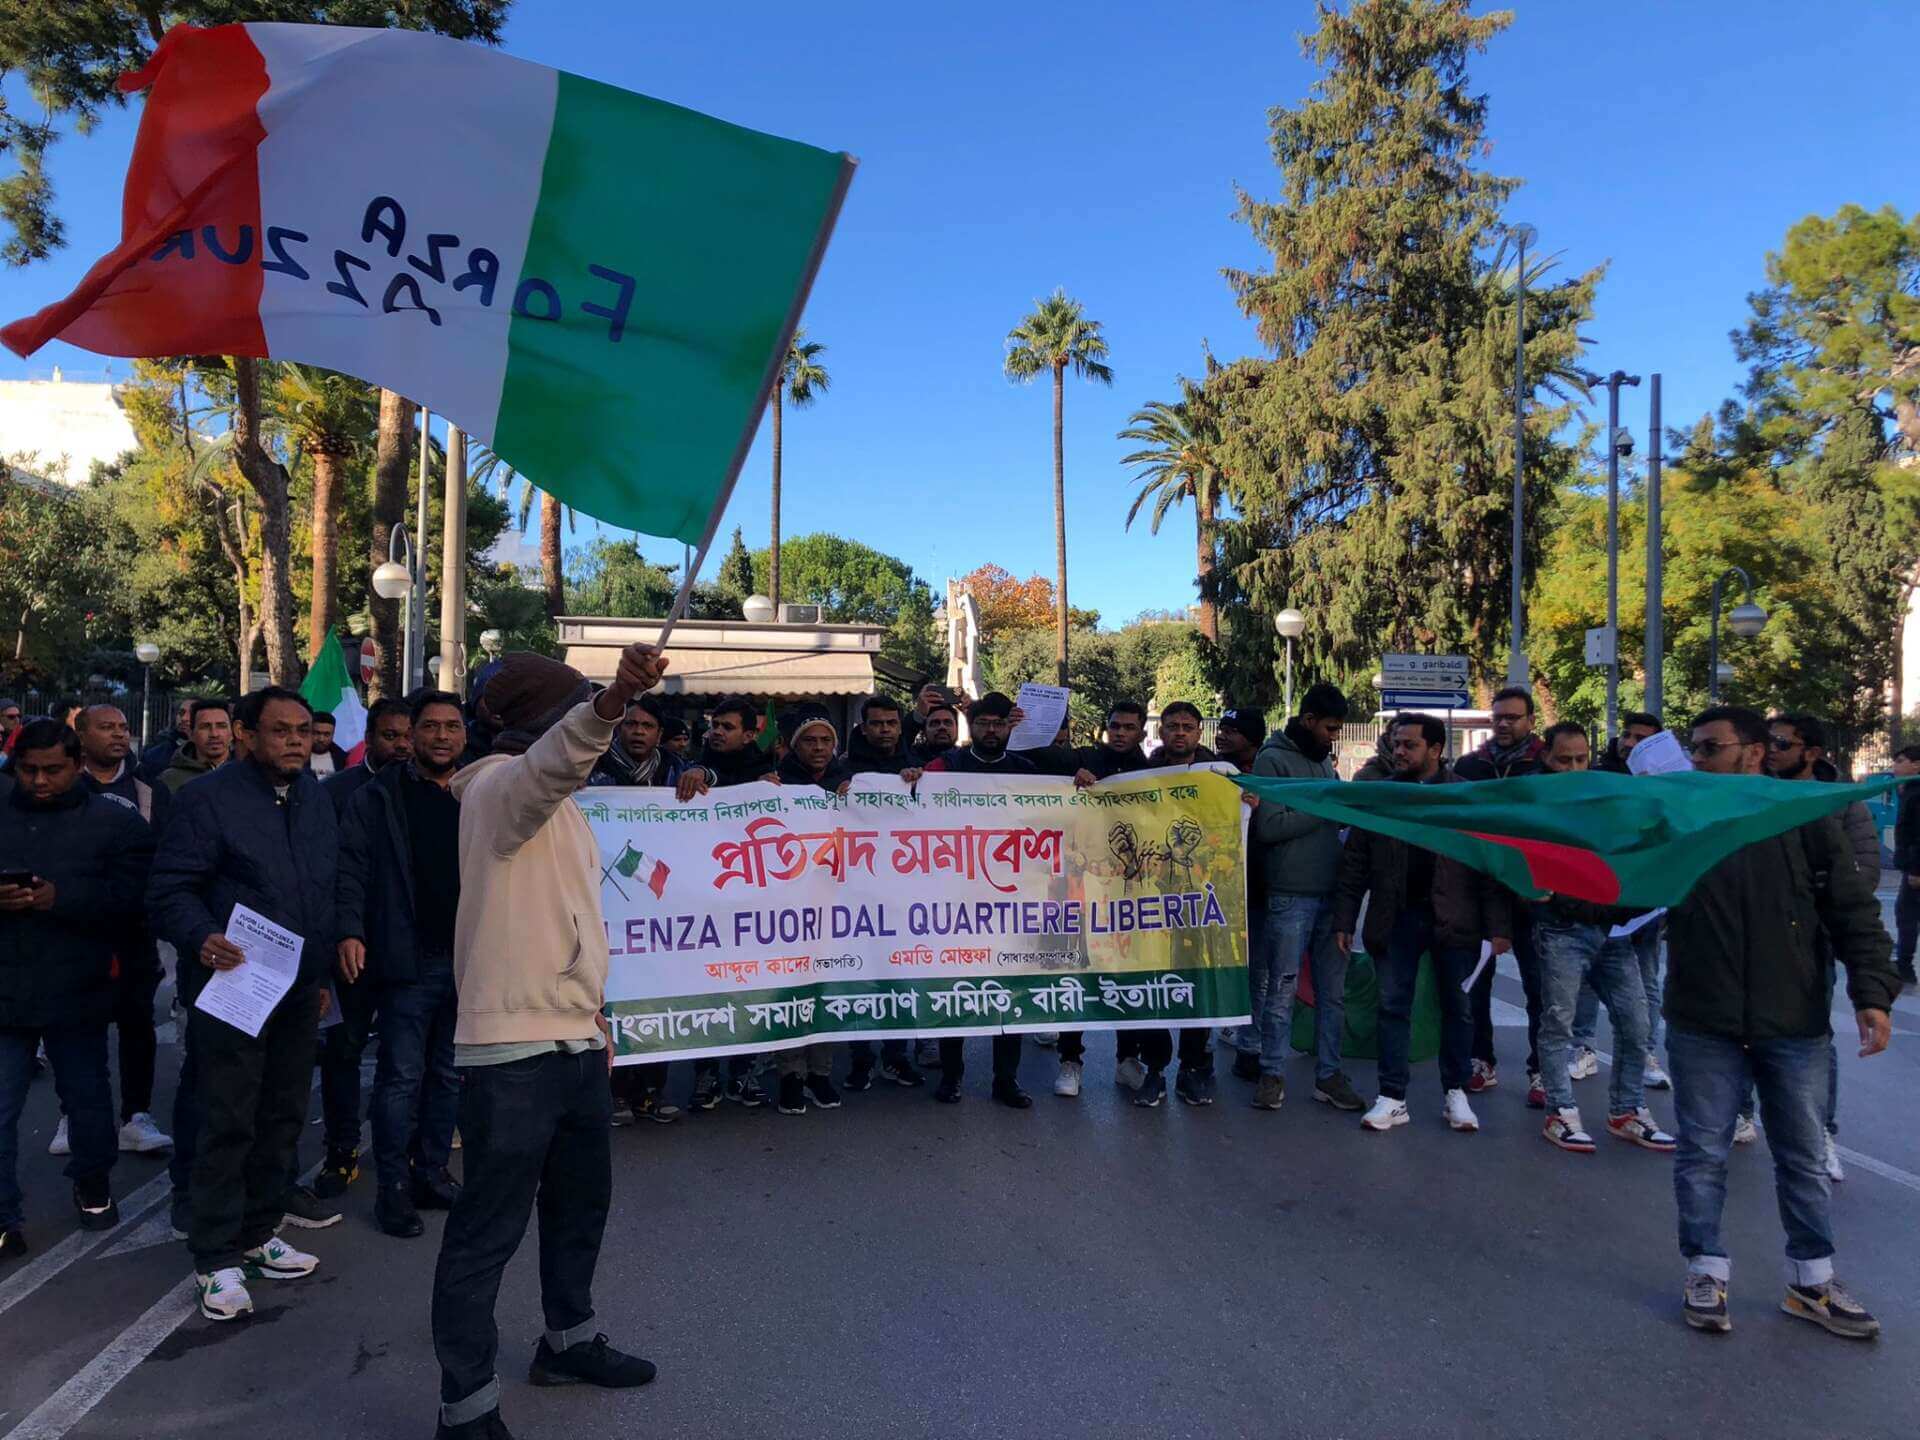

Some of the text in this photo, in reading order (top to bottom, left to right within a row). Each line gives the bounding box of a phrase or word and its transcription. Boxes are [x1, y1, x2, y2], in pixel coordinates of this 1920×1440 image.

[616, 802, 708, 824] নাগরিকদের
[1012, 792, 1062, 808] বসবাস
[711, 816, 1064, 893] প্রতিবাদ সমাবেশ
[733, 906, 822, 947] FUORI
[832, 903, 896, 939] DAL
[908, 901, 1081, 937] QUARTIERE
[1090, 882, 1226, 934] LIBERTÀ
[765, 955, 811, 975] কাদের
[605, 1001, 737, 1044] াংলাদেশ
[744, 995, 817, 1031] সমাজ
[821, 987, 920, 1022] কল্যাণ
[926, 979, 1023, 1018] সমিতি,
